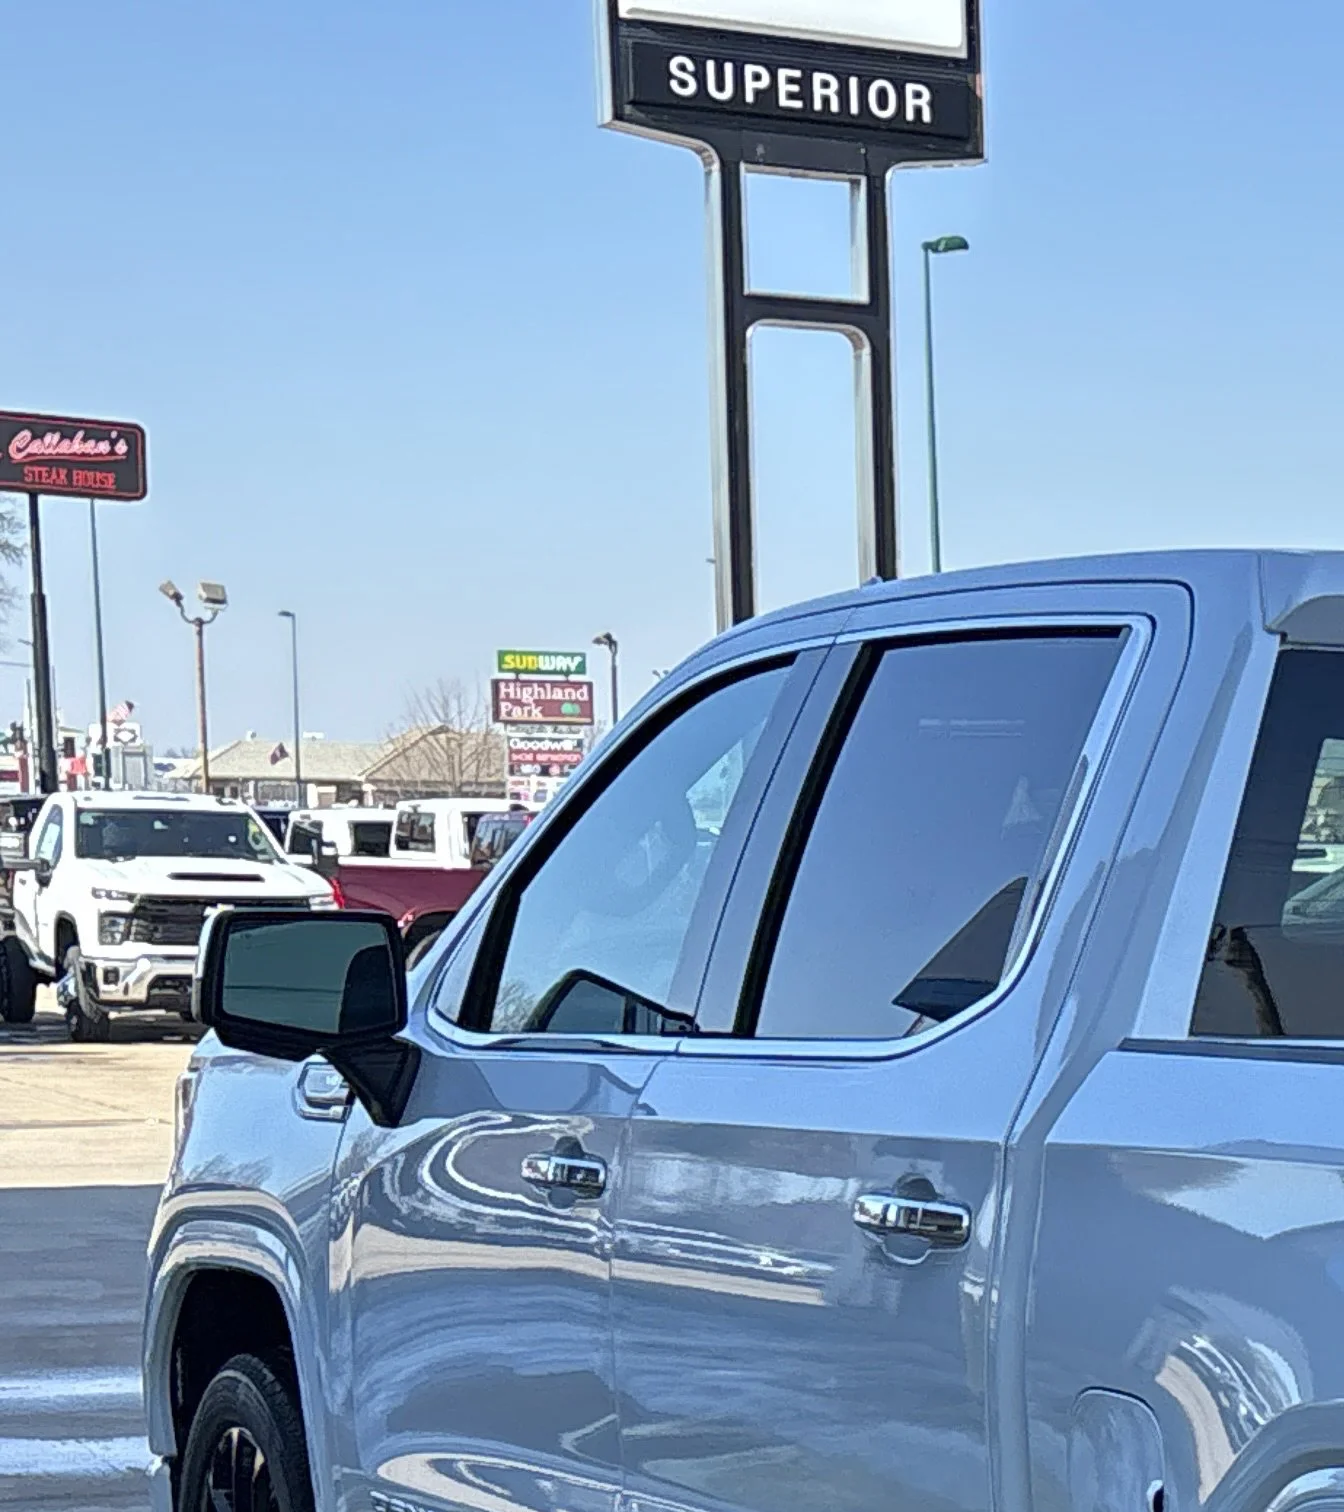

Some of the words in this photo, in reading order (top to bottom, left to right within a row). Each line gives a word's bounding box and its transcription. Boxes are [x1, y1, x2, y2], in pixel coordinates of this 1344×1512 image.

[668, 55, 932, 125] SUPERIOR
[8, 428, 129, 460] Callahan's
[23, 464, 69, 486] STEAK
[72, 468, 117, 490] HOUSE
[502, 653, 583, 672] SUBWAY
[499, 680, 590, 704] Highland
[500, 700, 544, 718] Park
